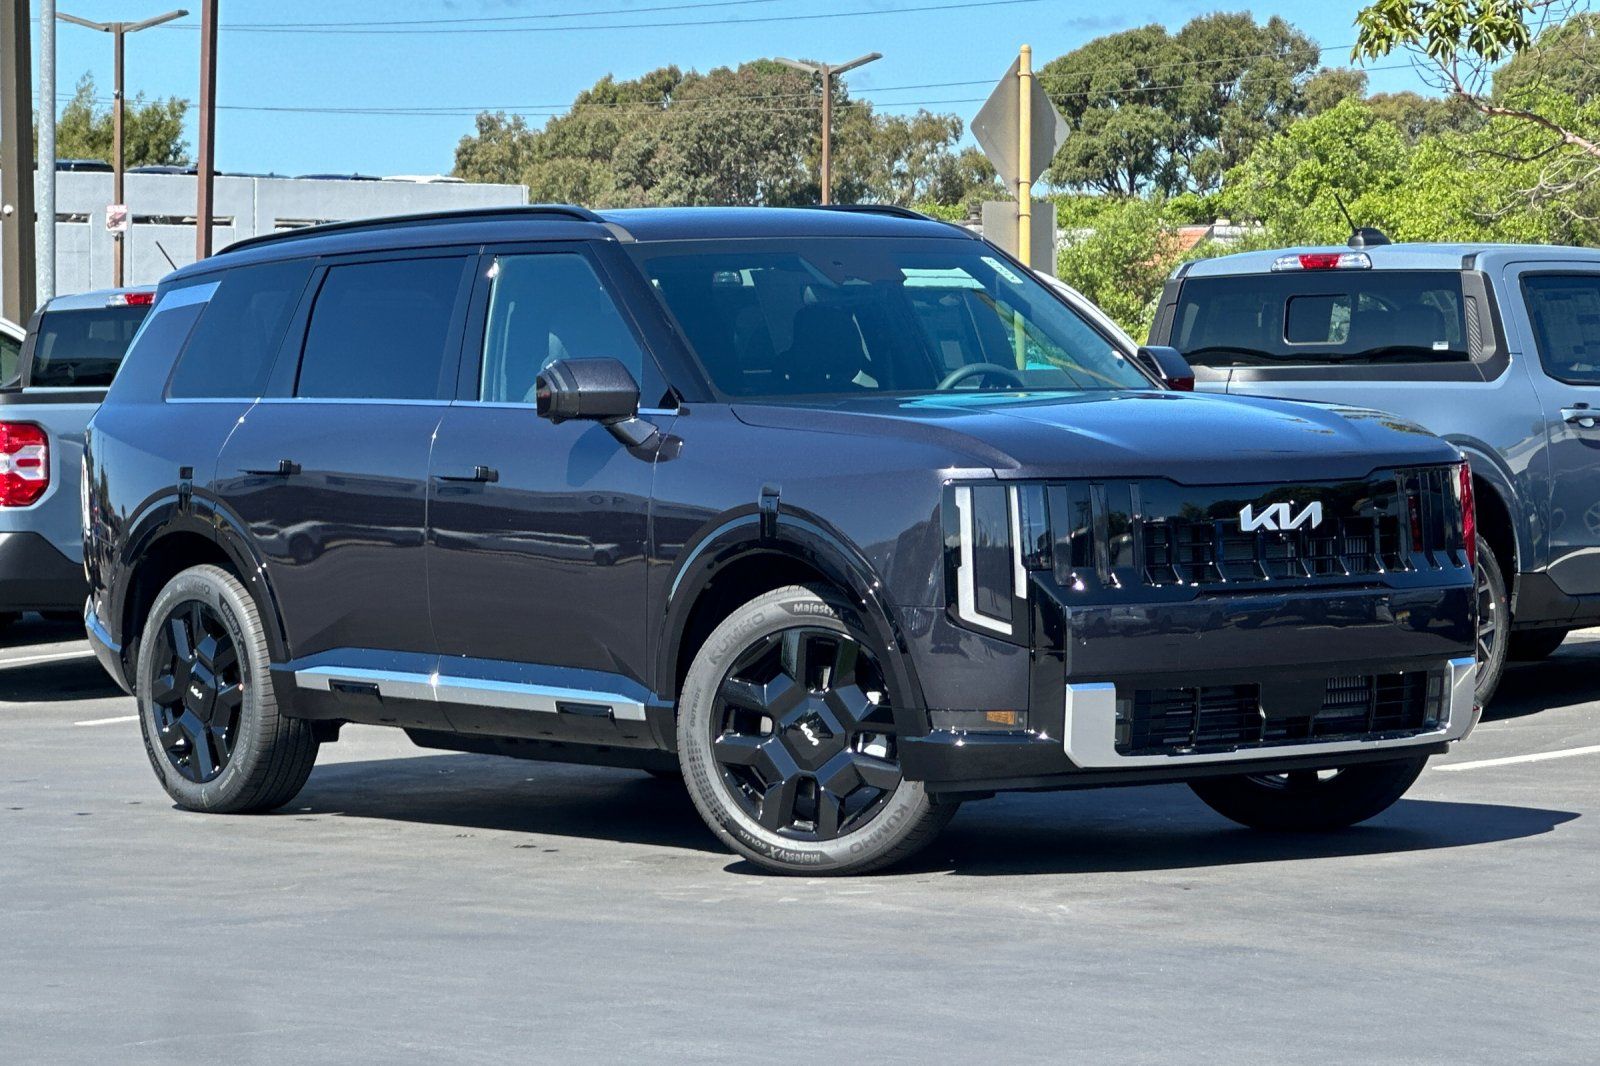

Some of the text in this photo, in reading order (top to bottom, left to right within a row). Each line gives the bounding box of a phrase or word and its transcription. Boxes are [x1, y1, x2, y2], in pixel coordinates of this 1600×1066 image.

[1239, 501, 1323, 531] KIA
[707, 611, 766, 665] KUMHO
[850, 803, 910, 853] KUMHO
